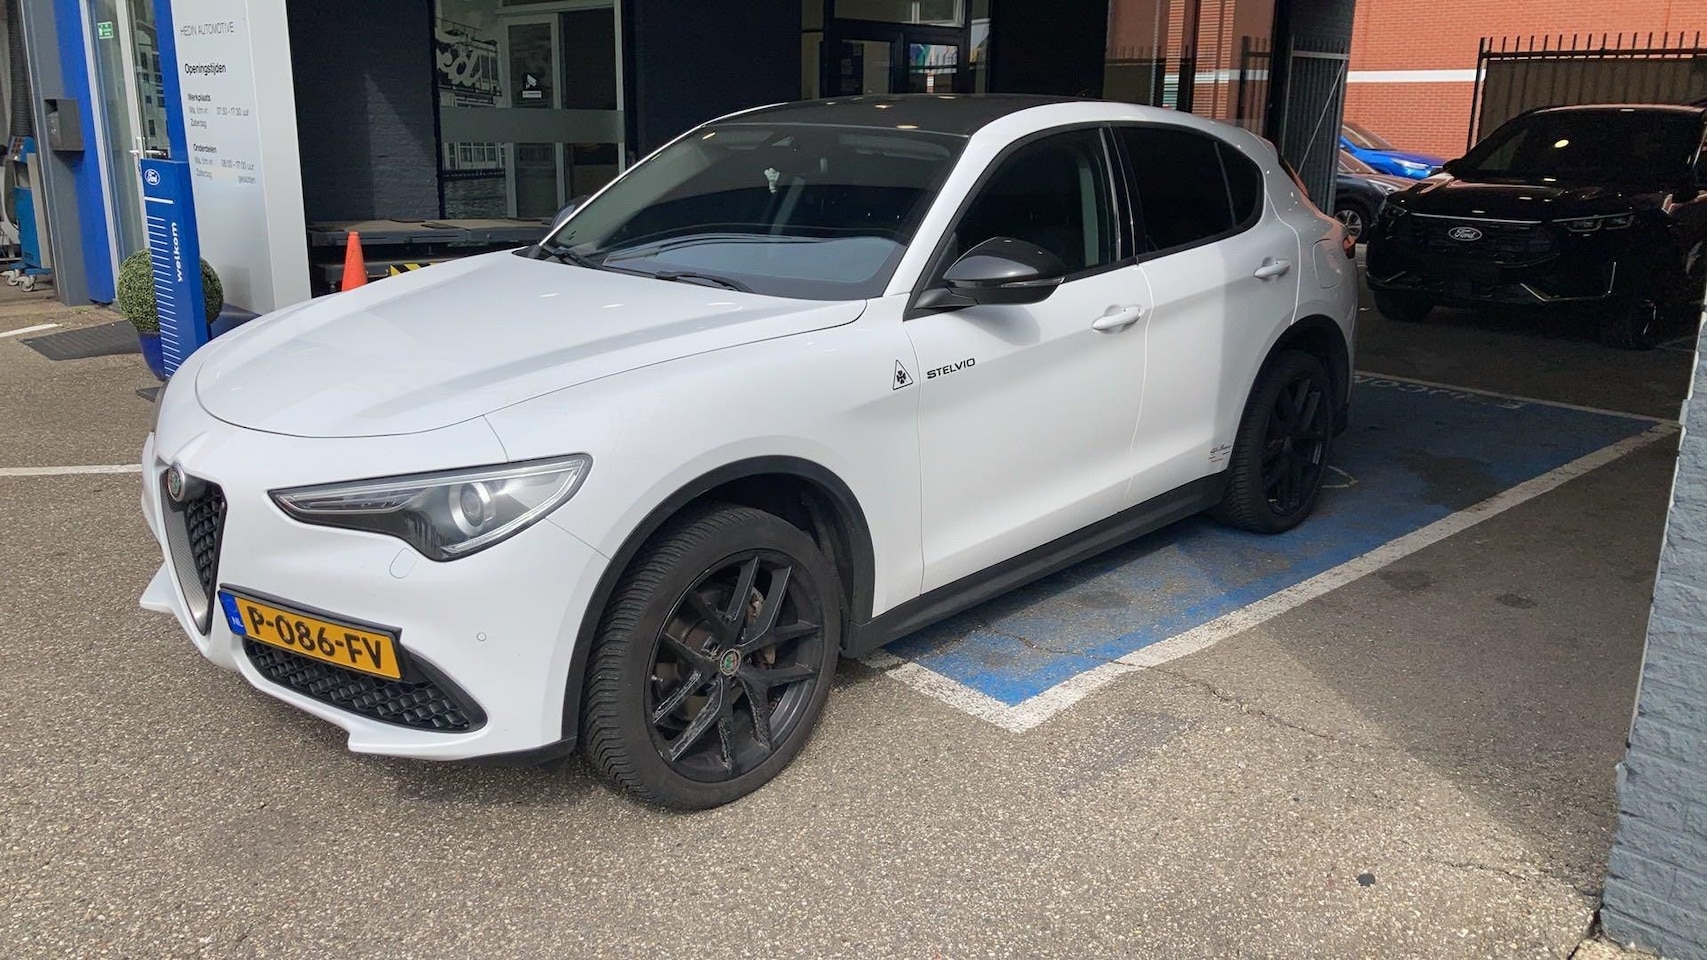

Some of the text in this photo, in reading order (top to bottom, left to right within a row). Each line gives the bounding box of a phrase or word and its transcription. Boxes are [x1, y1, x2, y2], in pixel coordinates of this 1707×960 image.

[180, 21, 234, 36] HEDIN AUTOMOTIVE
[184, 63, 227, 76] Openingstijden
[1454, 229, 1476, 239] Ford
[171, 221, 182, 283] welkom
[926, 357, 976, 379] STELVIO
[231, 615, 244, 628] NL
[246, 605, 382, 669] P-086-FV
